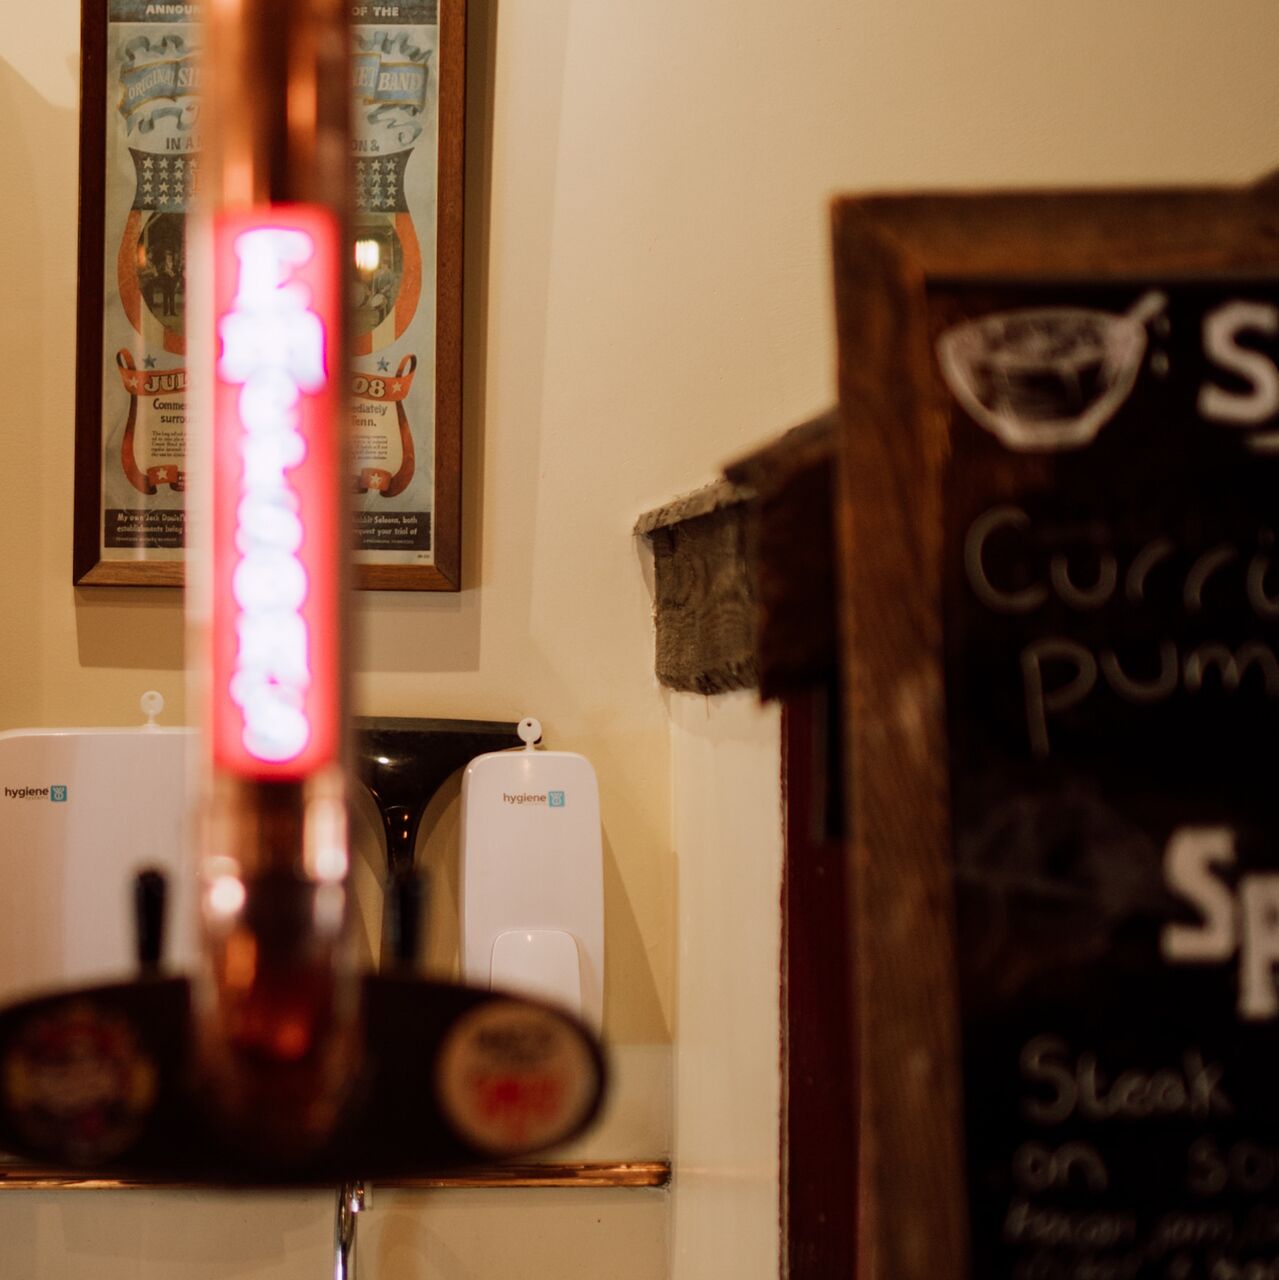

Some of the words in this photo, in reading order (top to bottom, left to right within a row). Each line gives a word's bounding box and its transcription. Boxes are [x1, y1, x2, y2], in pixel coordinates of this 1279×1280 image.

[373, 6, 400, 18] THE
[144, 373, 186, 393] JUL
[351, 377, 386, 398] 08
[1022, 637, 1279, 760] pum
[4, 786, 49, 799] hygiene
[503, 792, 547, 805] hygiene
